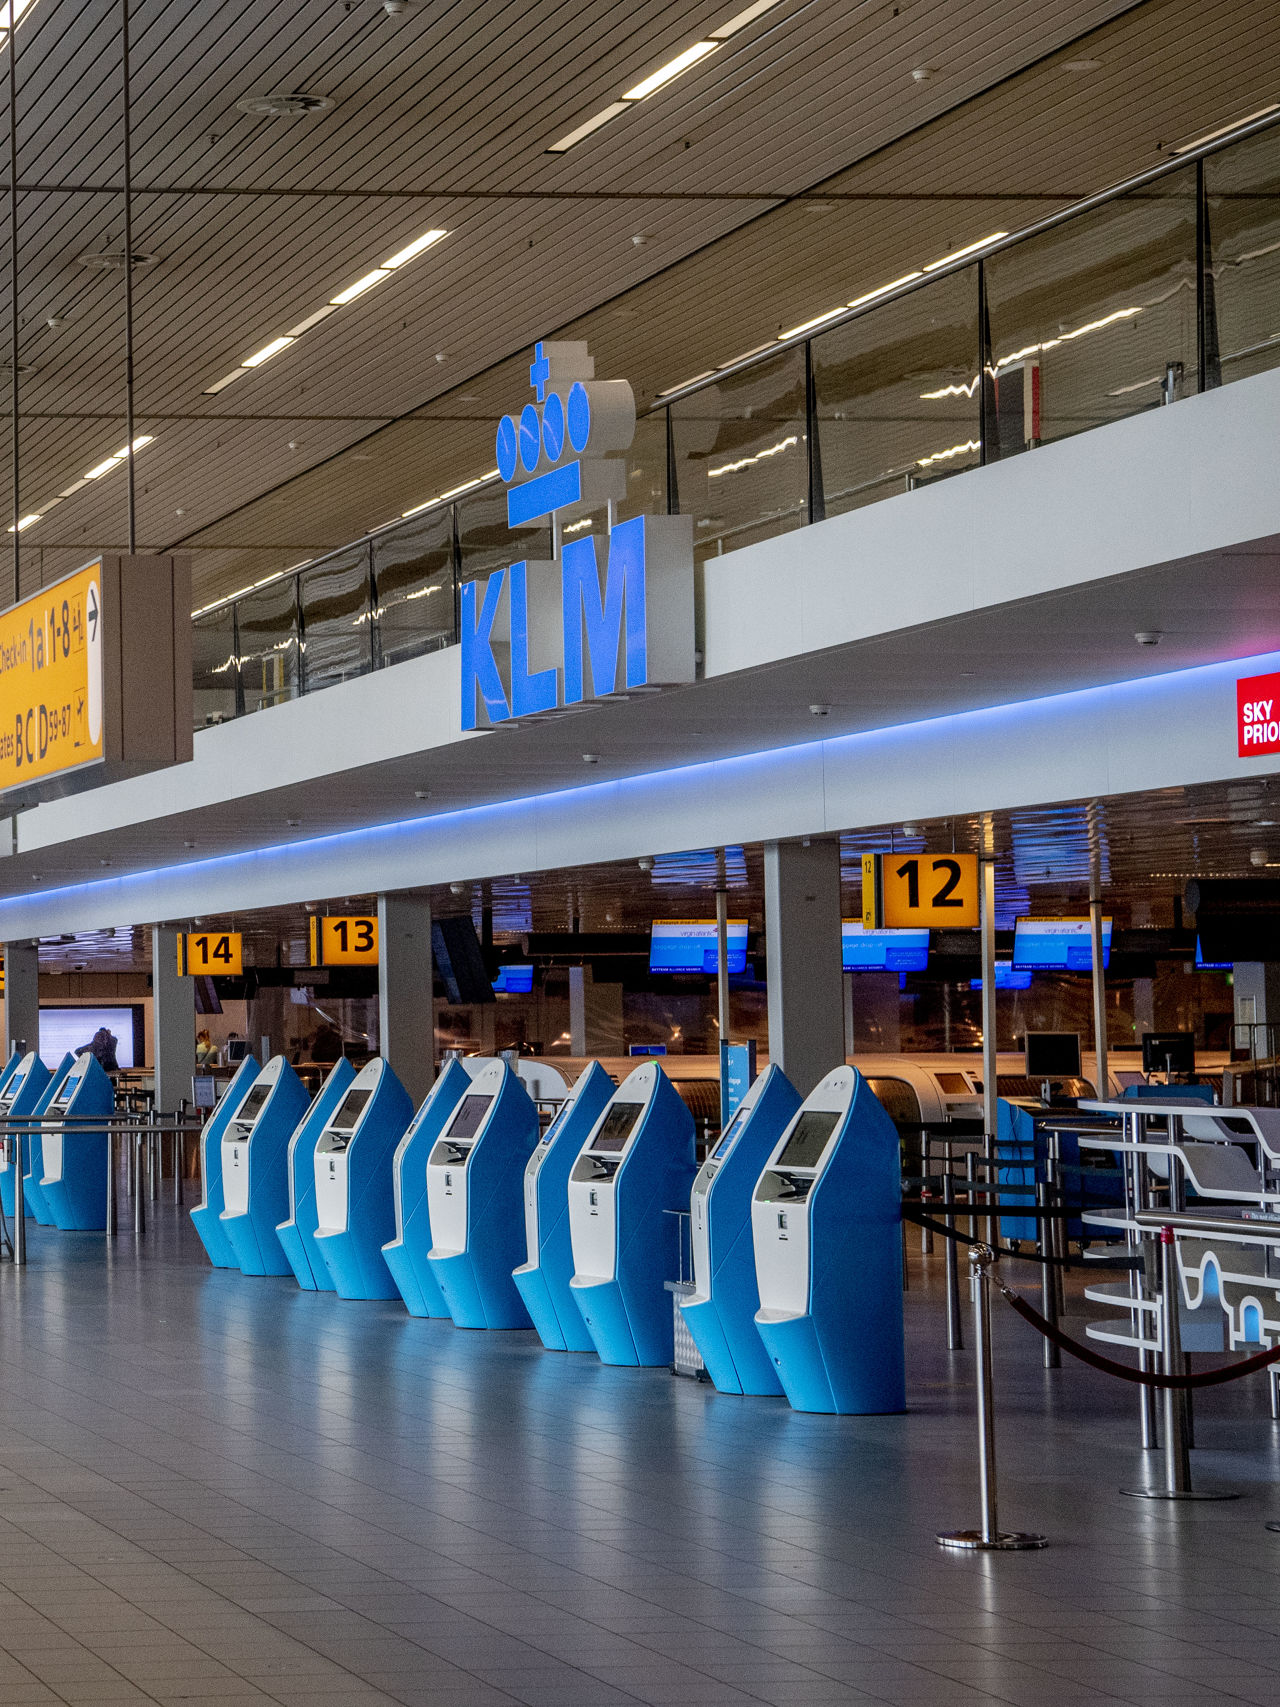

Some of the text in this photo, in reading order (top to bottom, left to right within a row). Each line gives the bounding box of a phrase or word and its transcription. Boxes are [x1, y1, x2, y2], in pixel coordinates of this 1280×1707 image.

[461, 514, 647, 731] KLM
[1243, 699, 1273, 723] SKY
[1244, 721, 1280, 746] PRIO
[864, 860, 872, 874] 12
[896, 859, 964, 908] 12
[194, 936, 233, 964] 14
[333, 920, 375, 953] 13
